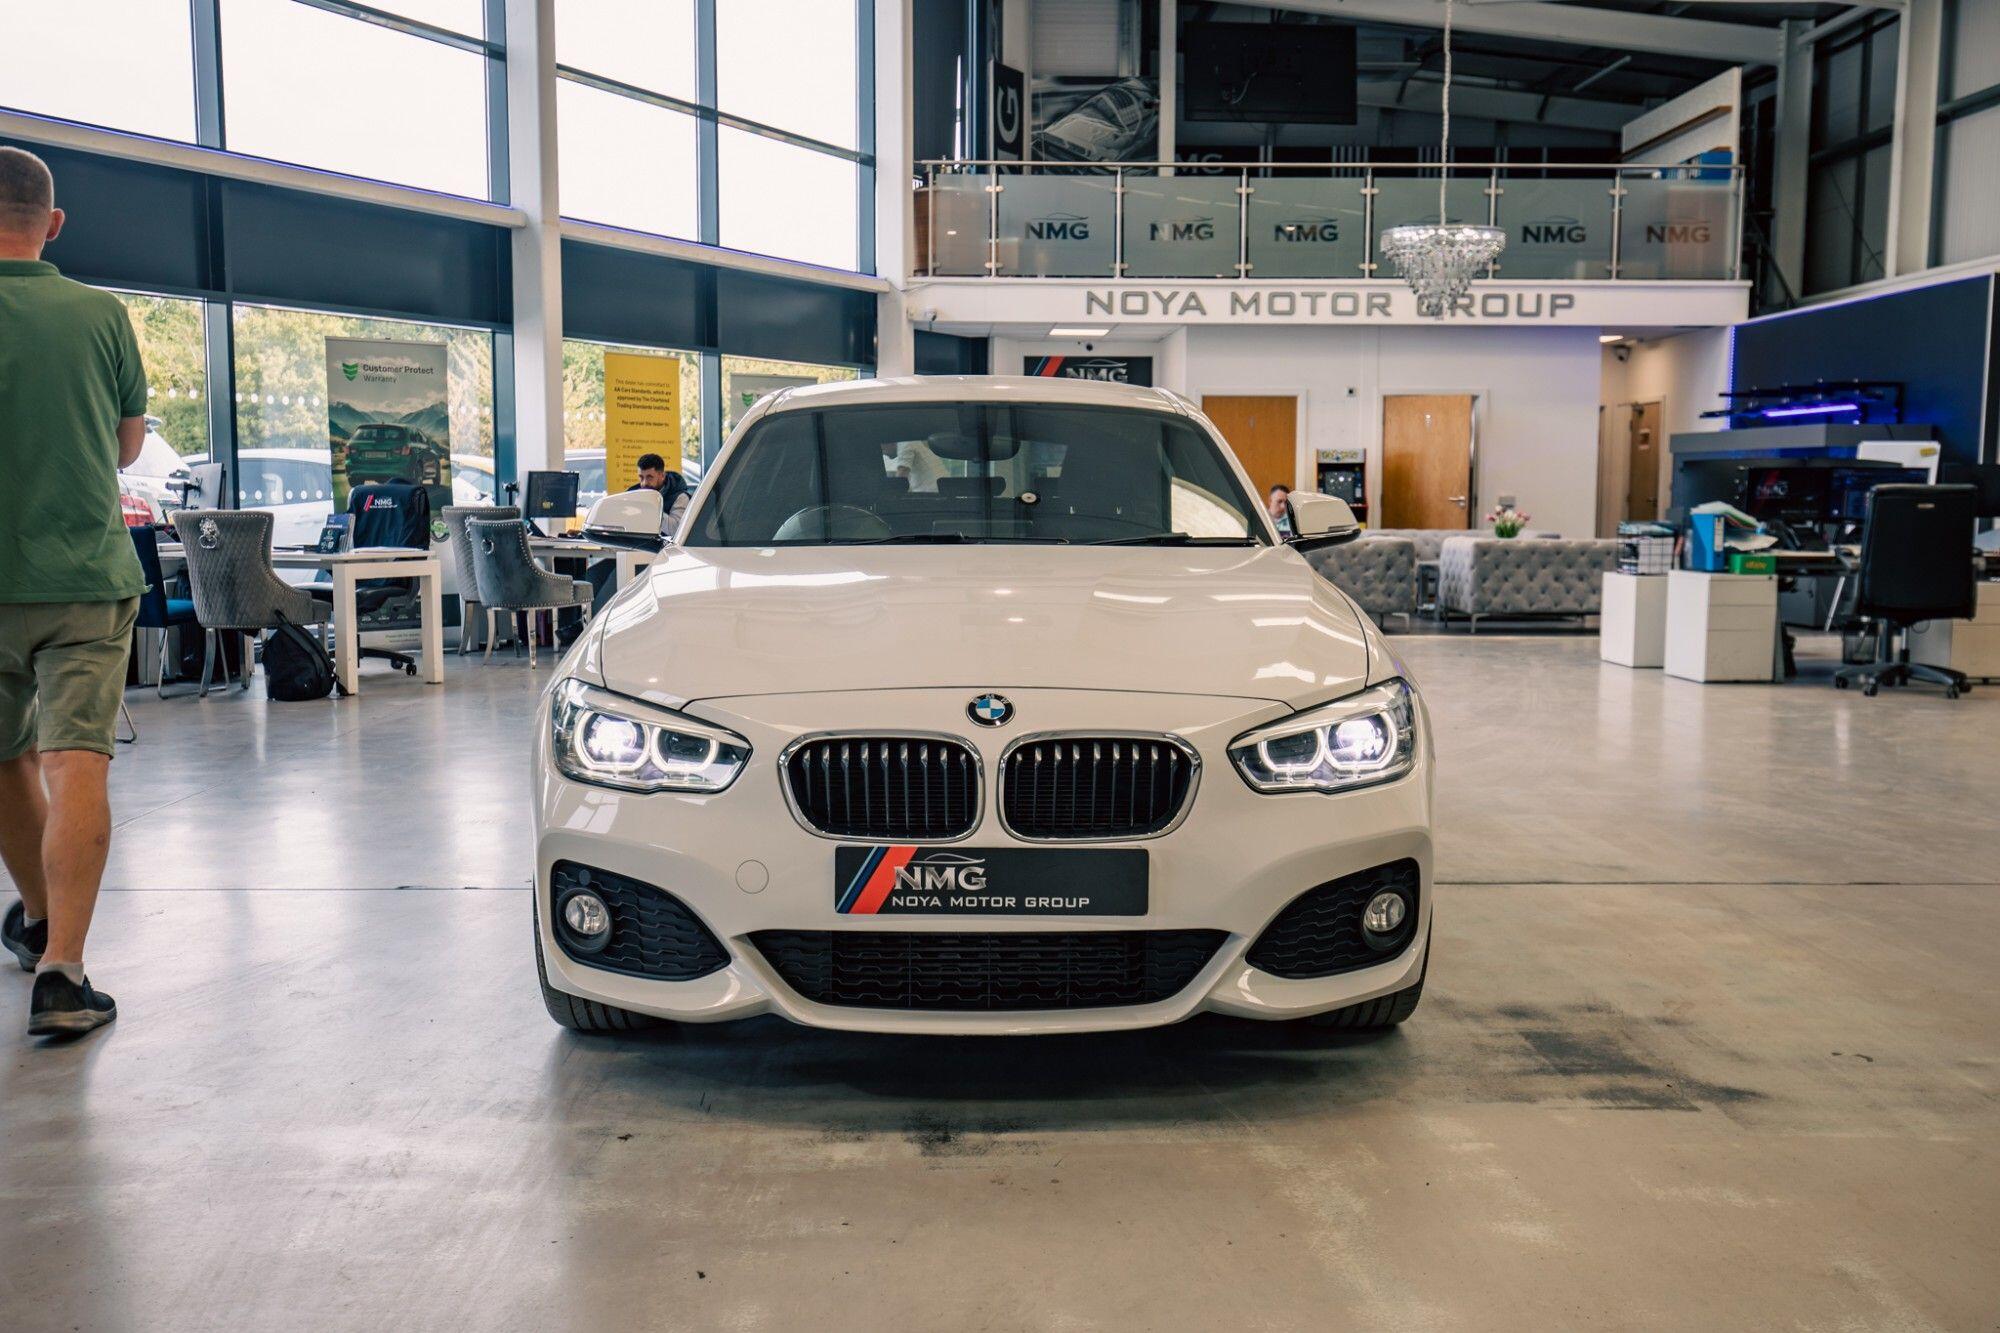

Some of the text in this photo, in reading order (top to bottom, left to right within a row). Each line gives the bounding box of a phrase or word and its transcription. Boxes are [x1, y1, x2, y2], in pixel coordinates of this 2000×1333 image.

[1024, 222, 1089, 240] NMG
[1150, 223, 1214, 241] NMG
[1274, 224, 1338, 242] NMG
[1521, 225, 1587, 243] NMG
[1645, 225, 1711, 244] NMG
[1086, 291, 1575, 317] NOYA MOTOR GROUP
[363, 364, 434, 374] Customer Protect
[1066, 367, 1128, 383] NMG
[363, 375, 397, 383] Warranty
[894, 866, 987, 890] NMG
[892, 896, 1090, 908] NOYA MOTOR GROUP
